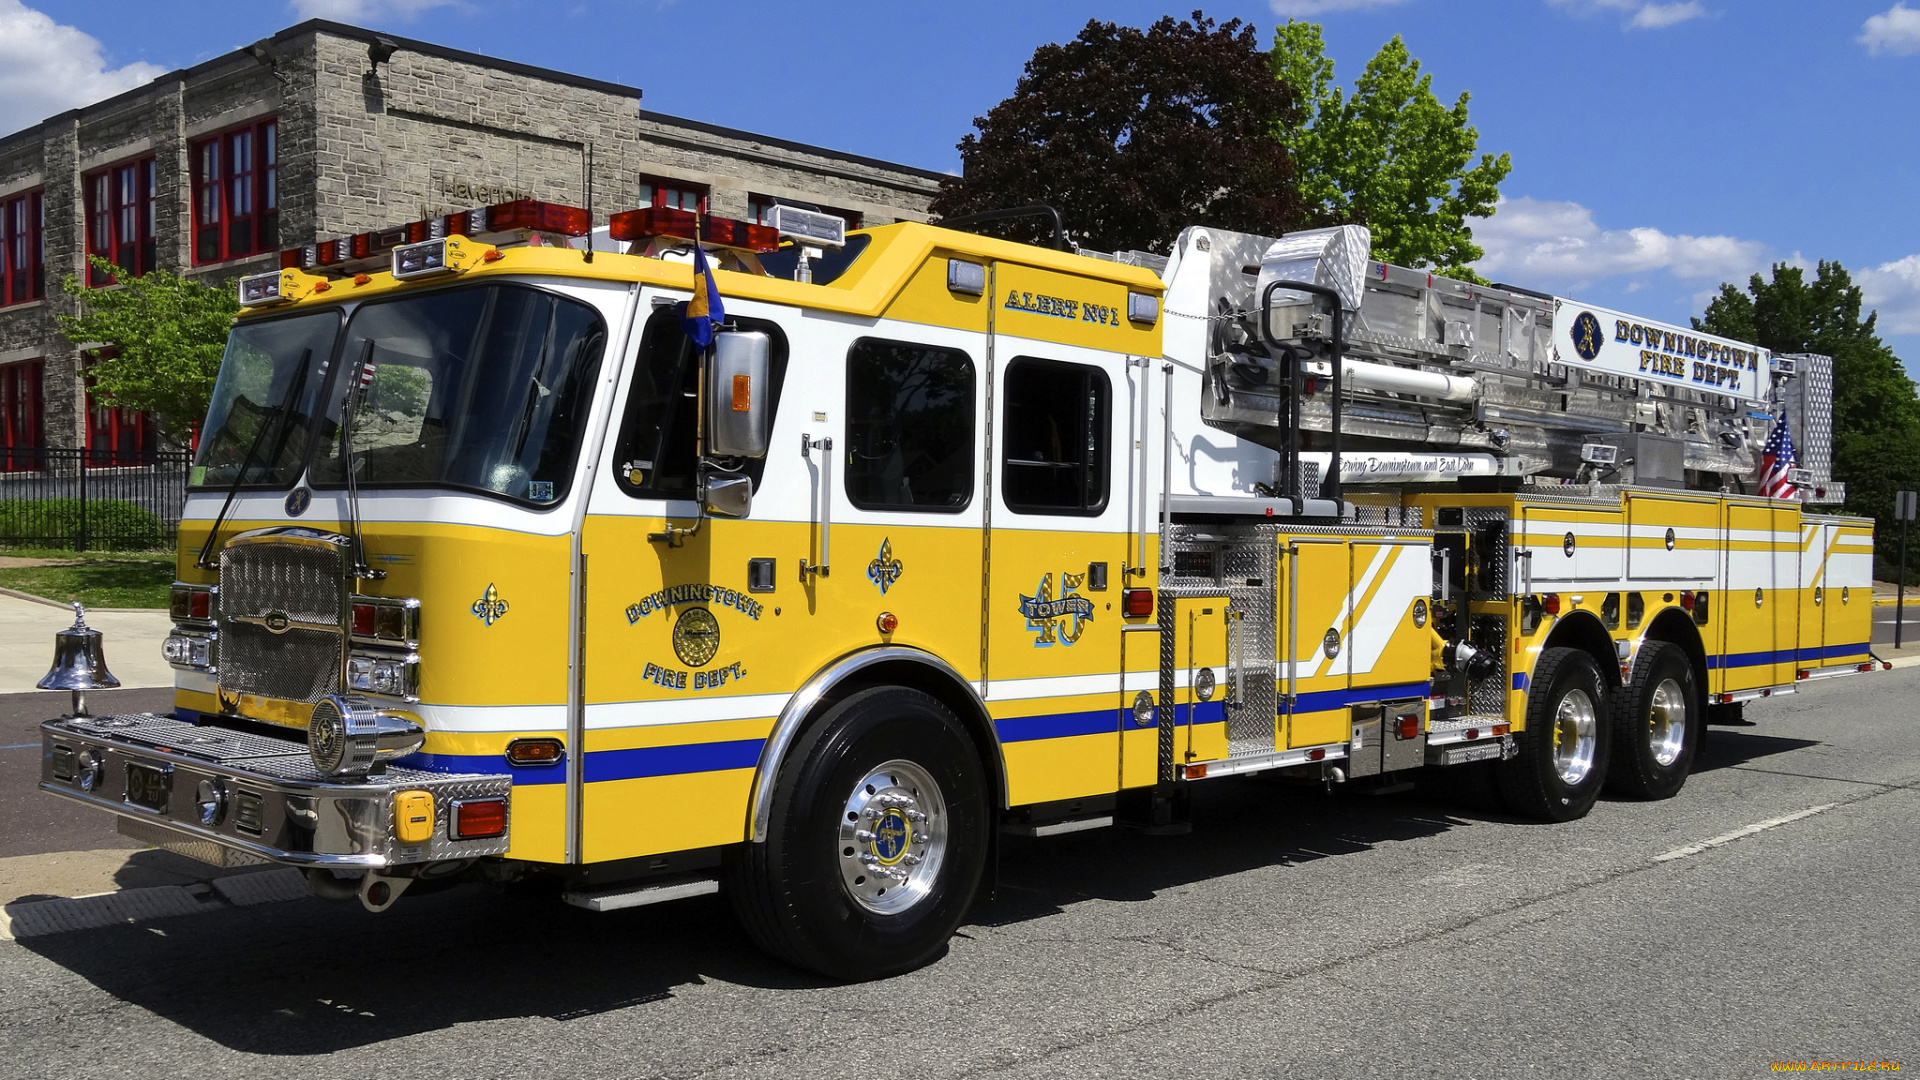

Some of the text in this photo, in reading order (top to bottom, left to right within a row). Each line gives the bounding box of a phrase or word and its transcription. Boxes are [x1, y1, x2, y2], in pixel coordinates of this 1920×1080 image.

[1004, 290, 1078, 318] ALERT
[1615, 320, 1759, 371] DOWNINGTOWN
[1639, 350, 1741, 391] FIRE DEPT.
[1368, 457, 1422, 476] Downingtown
[1424, 457, 1438, 471] and
[1439, 458, 1456, 473] East
[625, 584, 764, 625] DOWNINGTOWN
[1025, 600, 1089, 617] TOWER
[1026, 572, 1086, 648] 45
[642, 661, 747, 690] FIRE DEPT.
